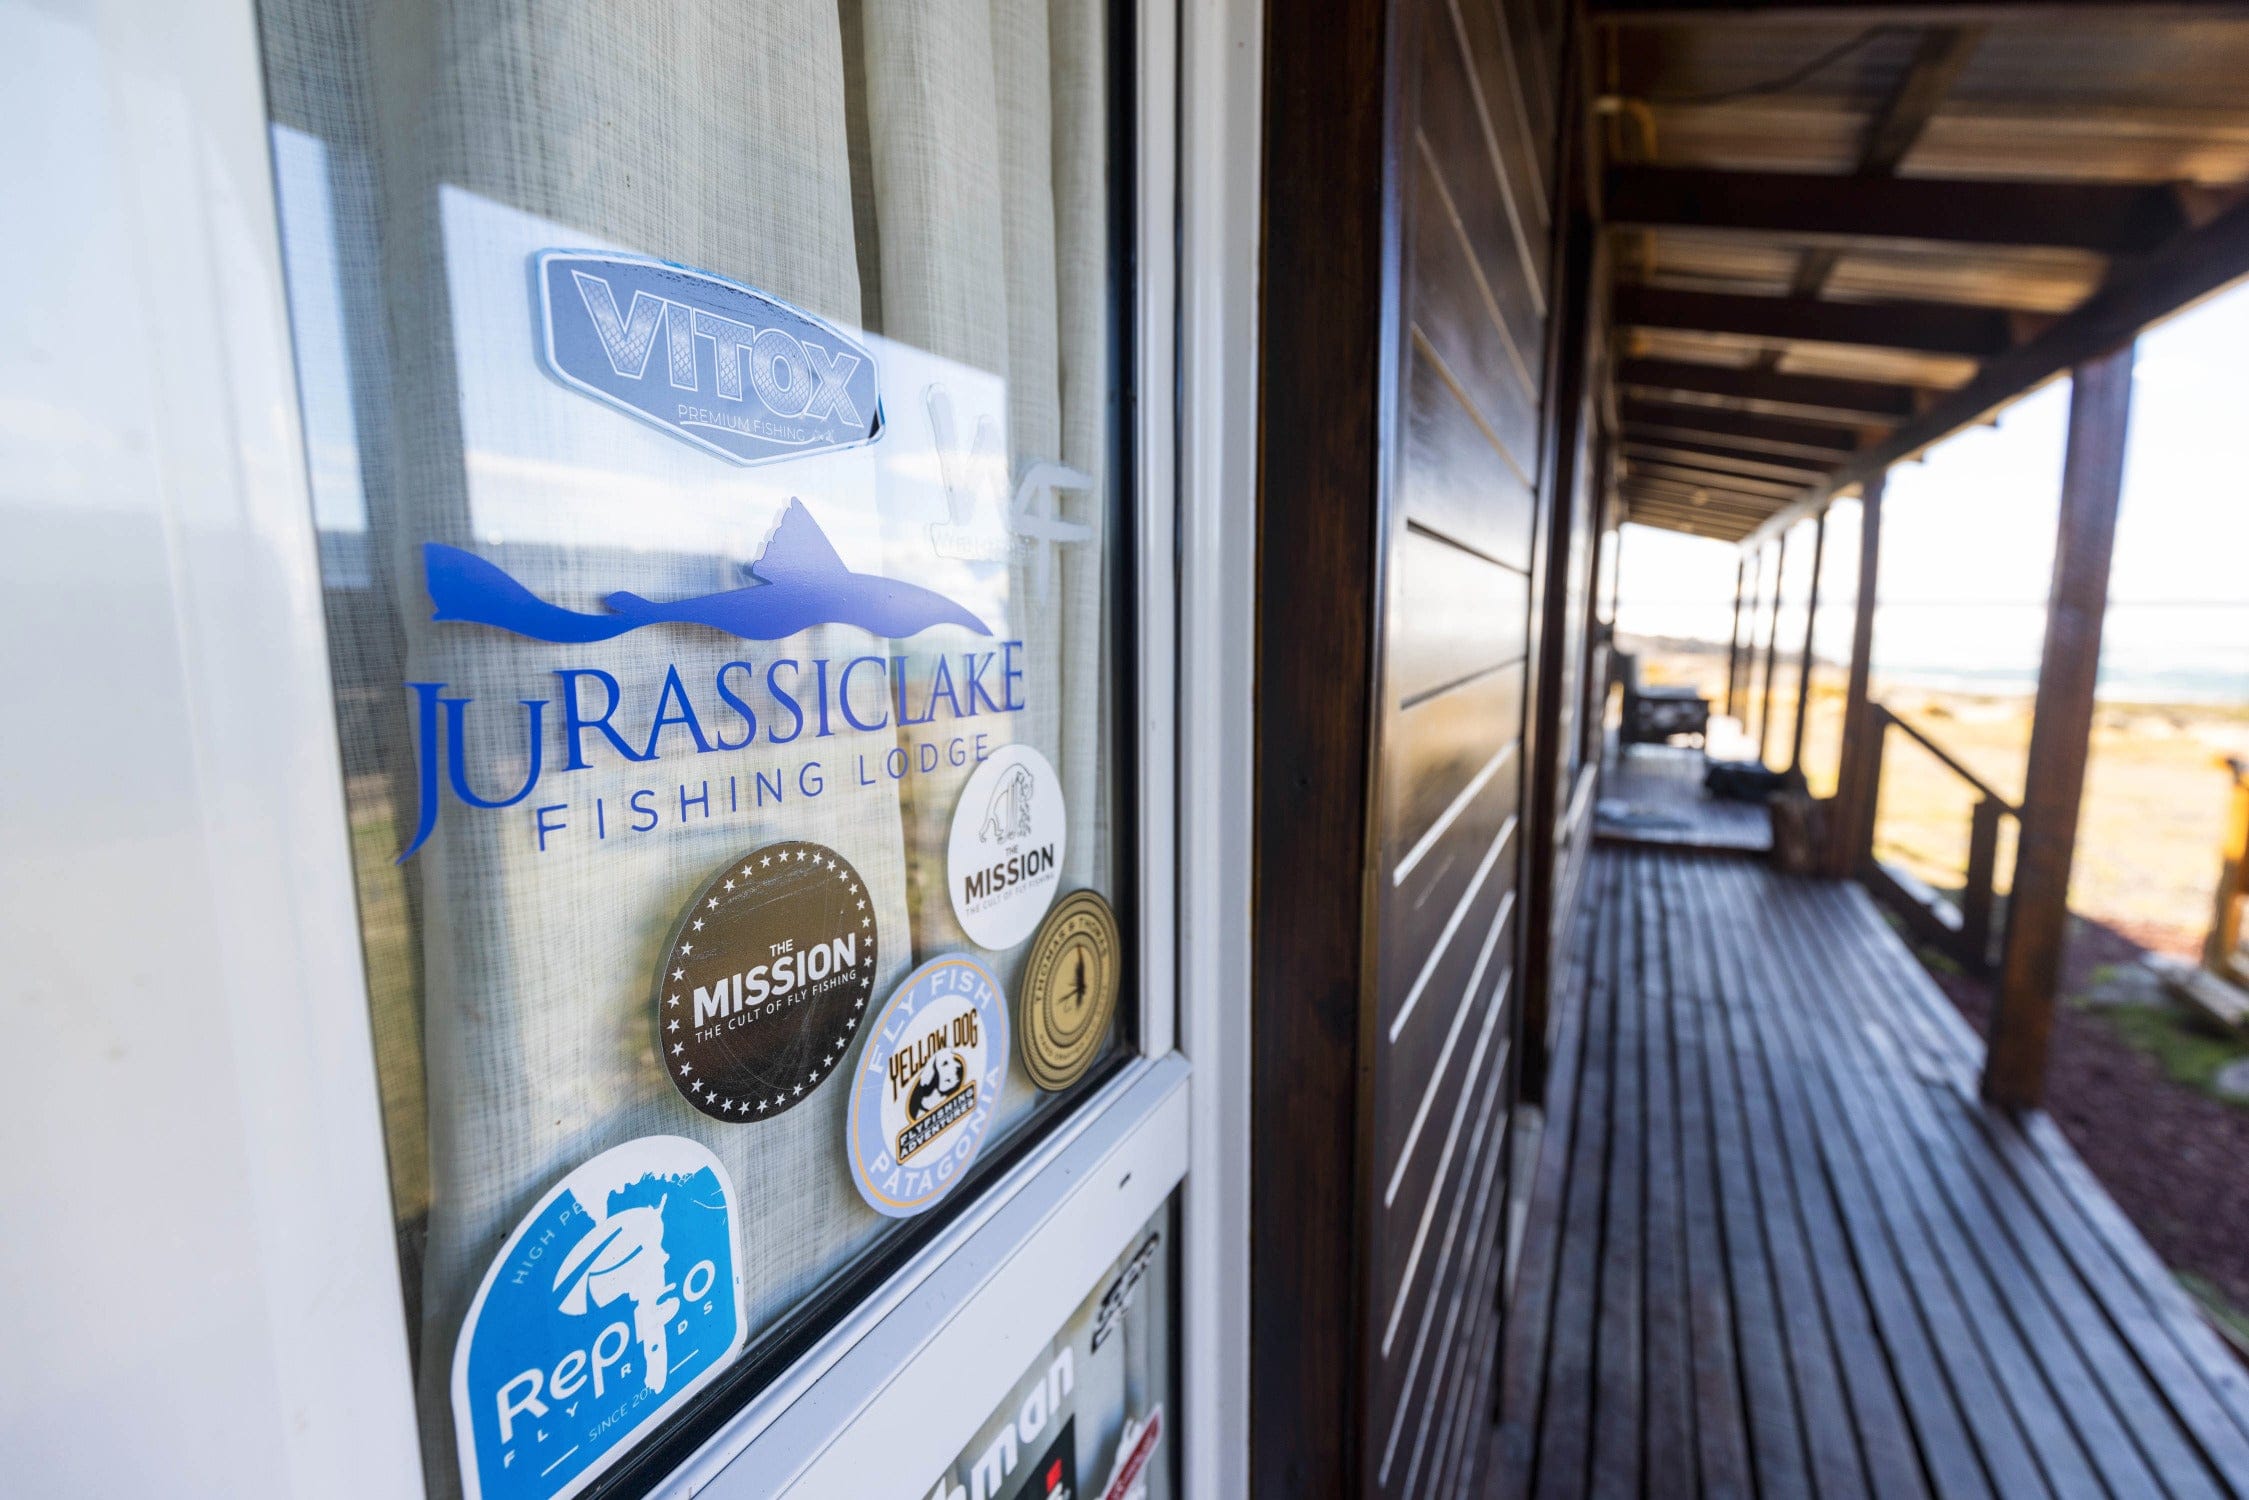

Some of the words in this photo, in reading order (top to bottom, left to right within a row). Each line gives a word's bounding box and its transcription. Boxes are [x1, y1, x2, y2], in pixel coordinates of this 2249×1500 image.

[571, 269, 864, 427] VITOX
[678, 404, 749, 431] PREMIUM
[753, 420, 806, 442] FISHING
[536, 761, 825, 852] FISHING
[859, 733, 989, 786] LODGE
[965, 843, 1054, 905] MISSION
[1005, 844, 1018, 857] THE
[693, 932, 856, 1029] MISSION
[769, 938, 794, 957] THE
[695, 1024, 722, 1044] THE
[728, 1008, 761, 1030] CULT
[766, 1000, 782, 1015] OF
[787, 989, 808, 1006] FLY
[812, 969, 857, 996] FISHING
[868, 989, 917, 1075] FLY
[929, 967, 993, 1010] FISH
[889, 1023, 948, 1104] YELLOW
[953, 1007, 978, 1049] DOG
[870, 1065, 1000, 1198] PATAGONIA
[511, 1229, 555, 1285] HIGH
[588, 1402, 629, 1442] SINCE
